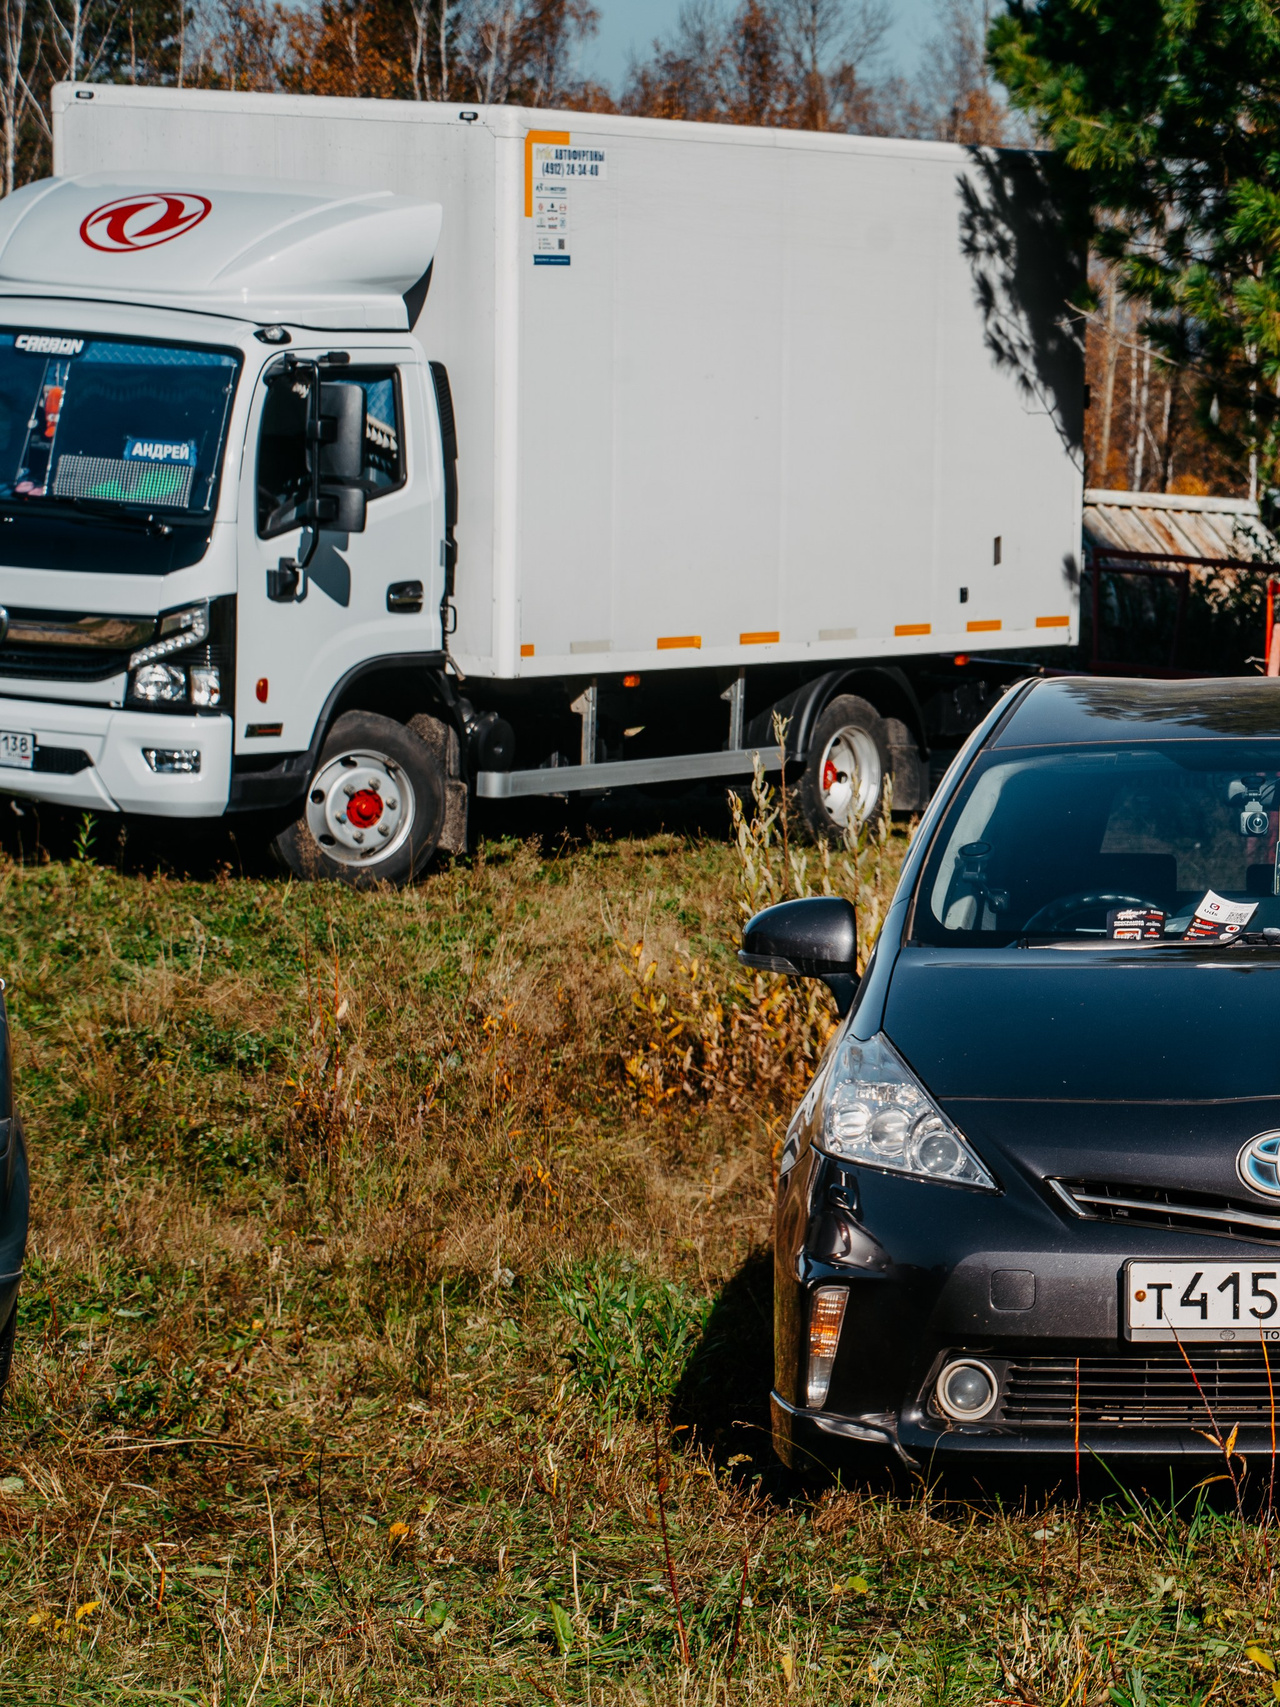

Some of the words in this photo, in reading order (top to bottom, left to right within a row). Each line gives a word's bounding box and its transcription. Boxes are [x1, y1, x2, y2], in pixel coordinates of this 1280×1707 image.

[554, 148, 605, 162] АВТОФУРГОНЫ
[14, 334, 84, 355] CARBON
[131, 441, 190, 460] АНДРЕЙ
[2, 735, 28, 753] 138
